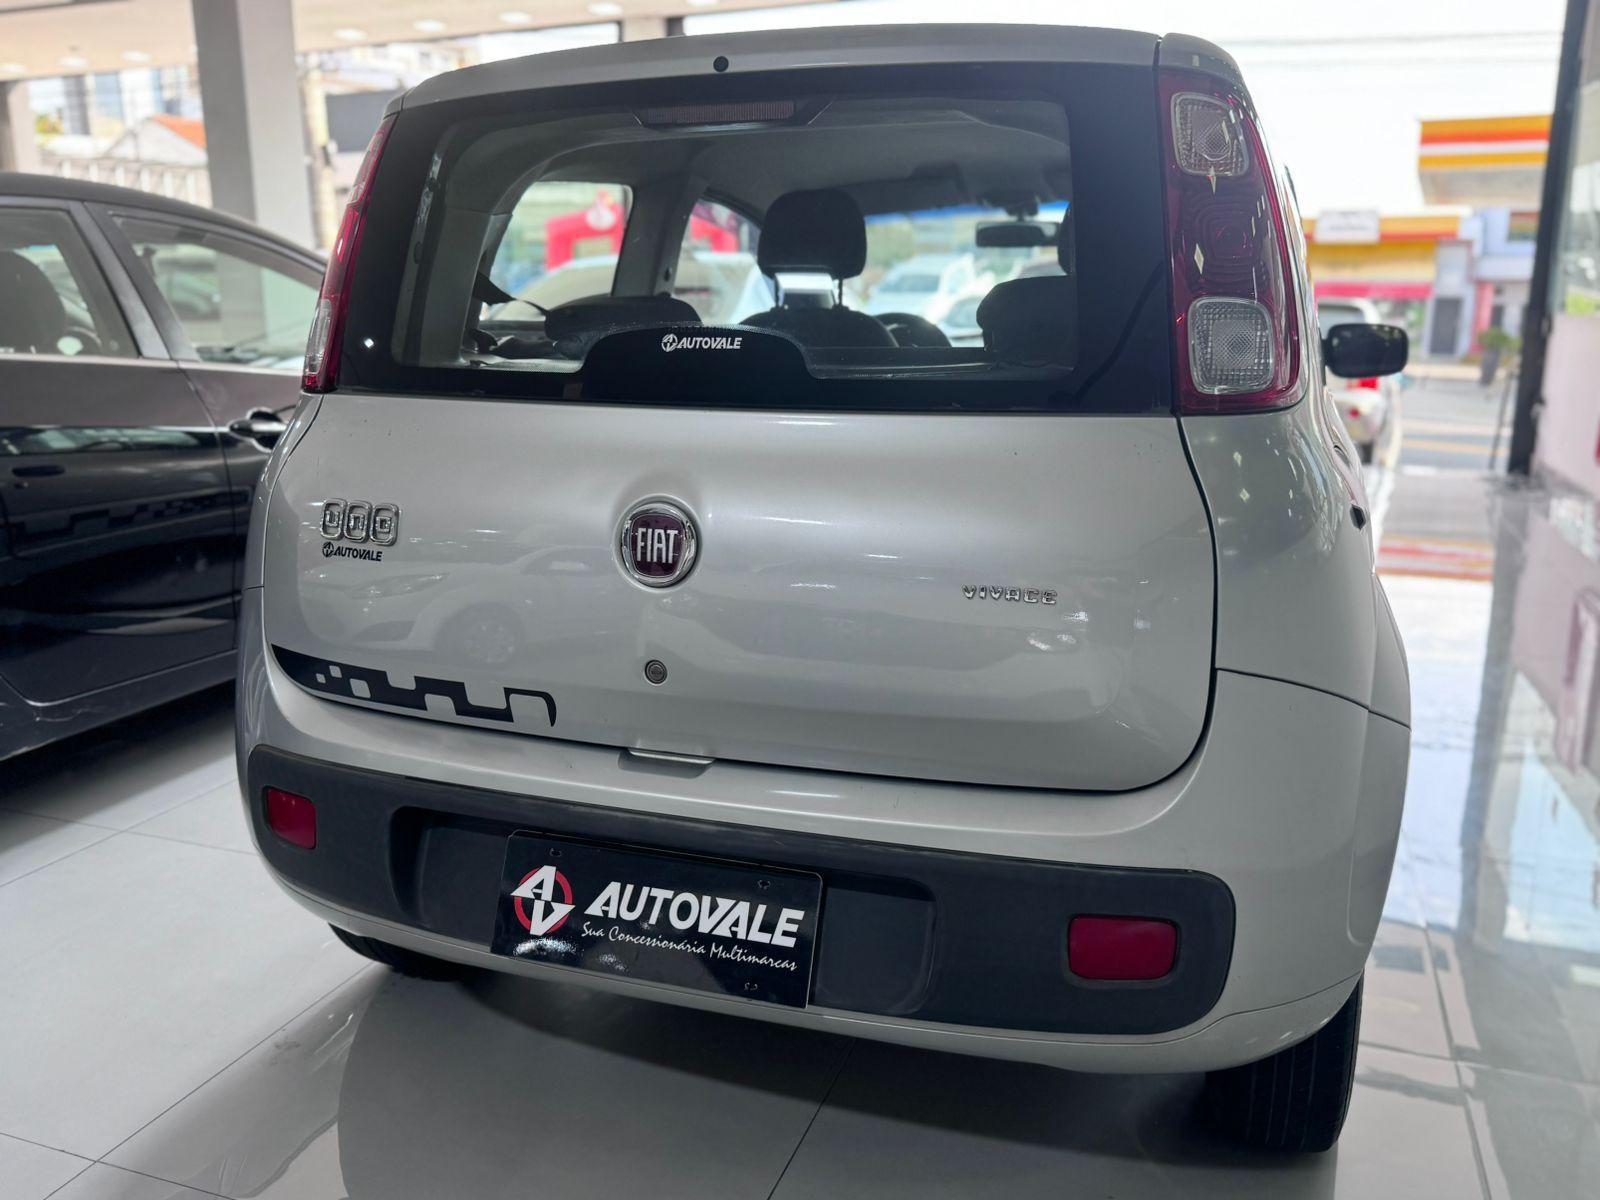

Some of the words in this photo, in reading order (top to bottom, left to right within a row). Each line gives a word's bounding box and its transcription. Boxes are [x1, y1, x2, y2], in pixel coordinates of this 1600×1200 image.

[676, 337, 743, 350] AUTOVALE
[333, 546, 383, 562] AUTOVALE
[636, 527, 679, 564] FIAT
[961, 584, 1058, 605] VIVACE
[584, 881, 805, 948] AUTOVALE
[581, 921, 604, 938] Sua
[708, 944, 797, 971] Multimarcas
